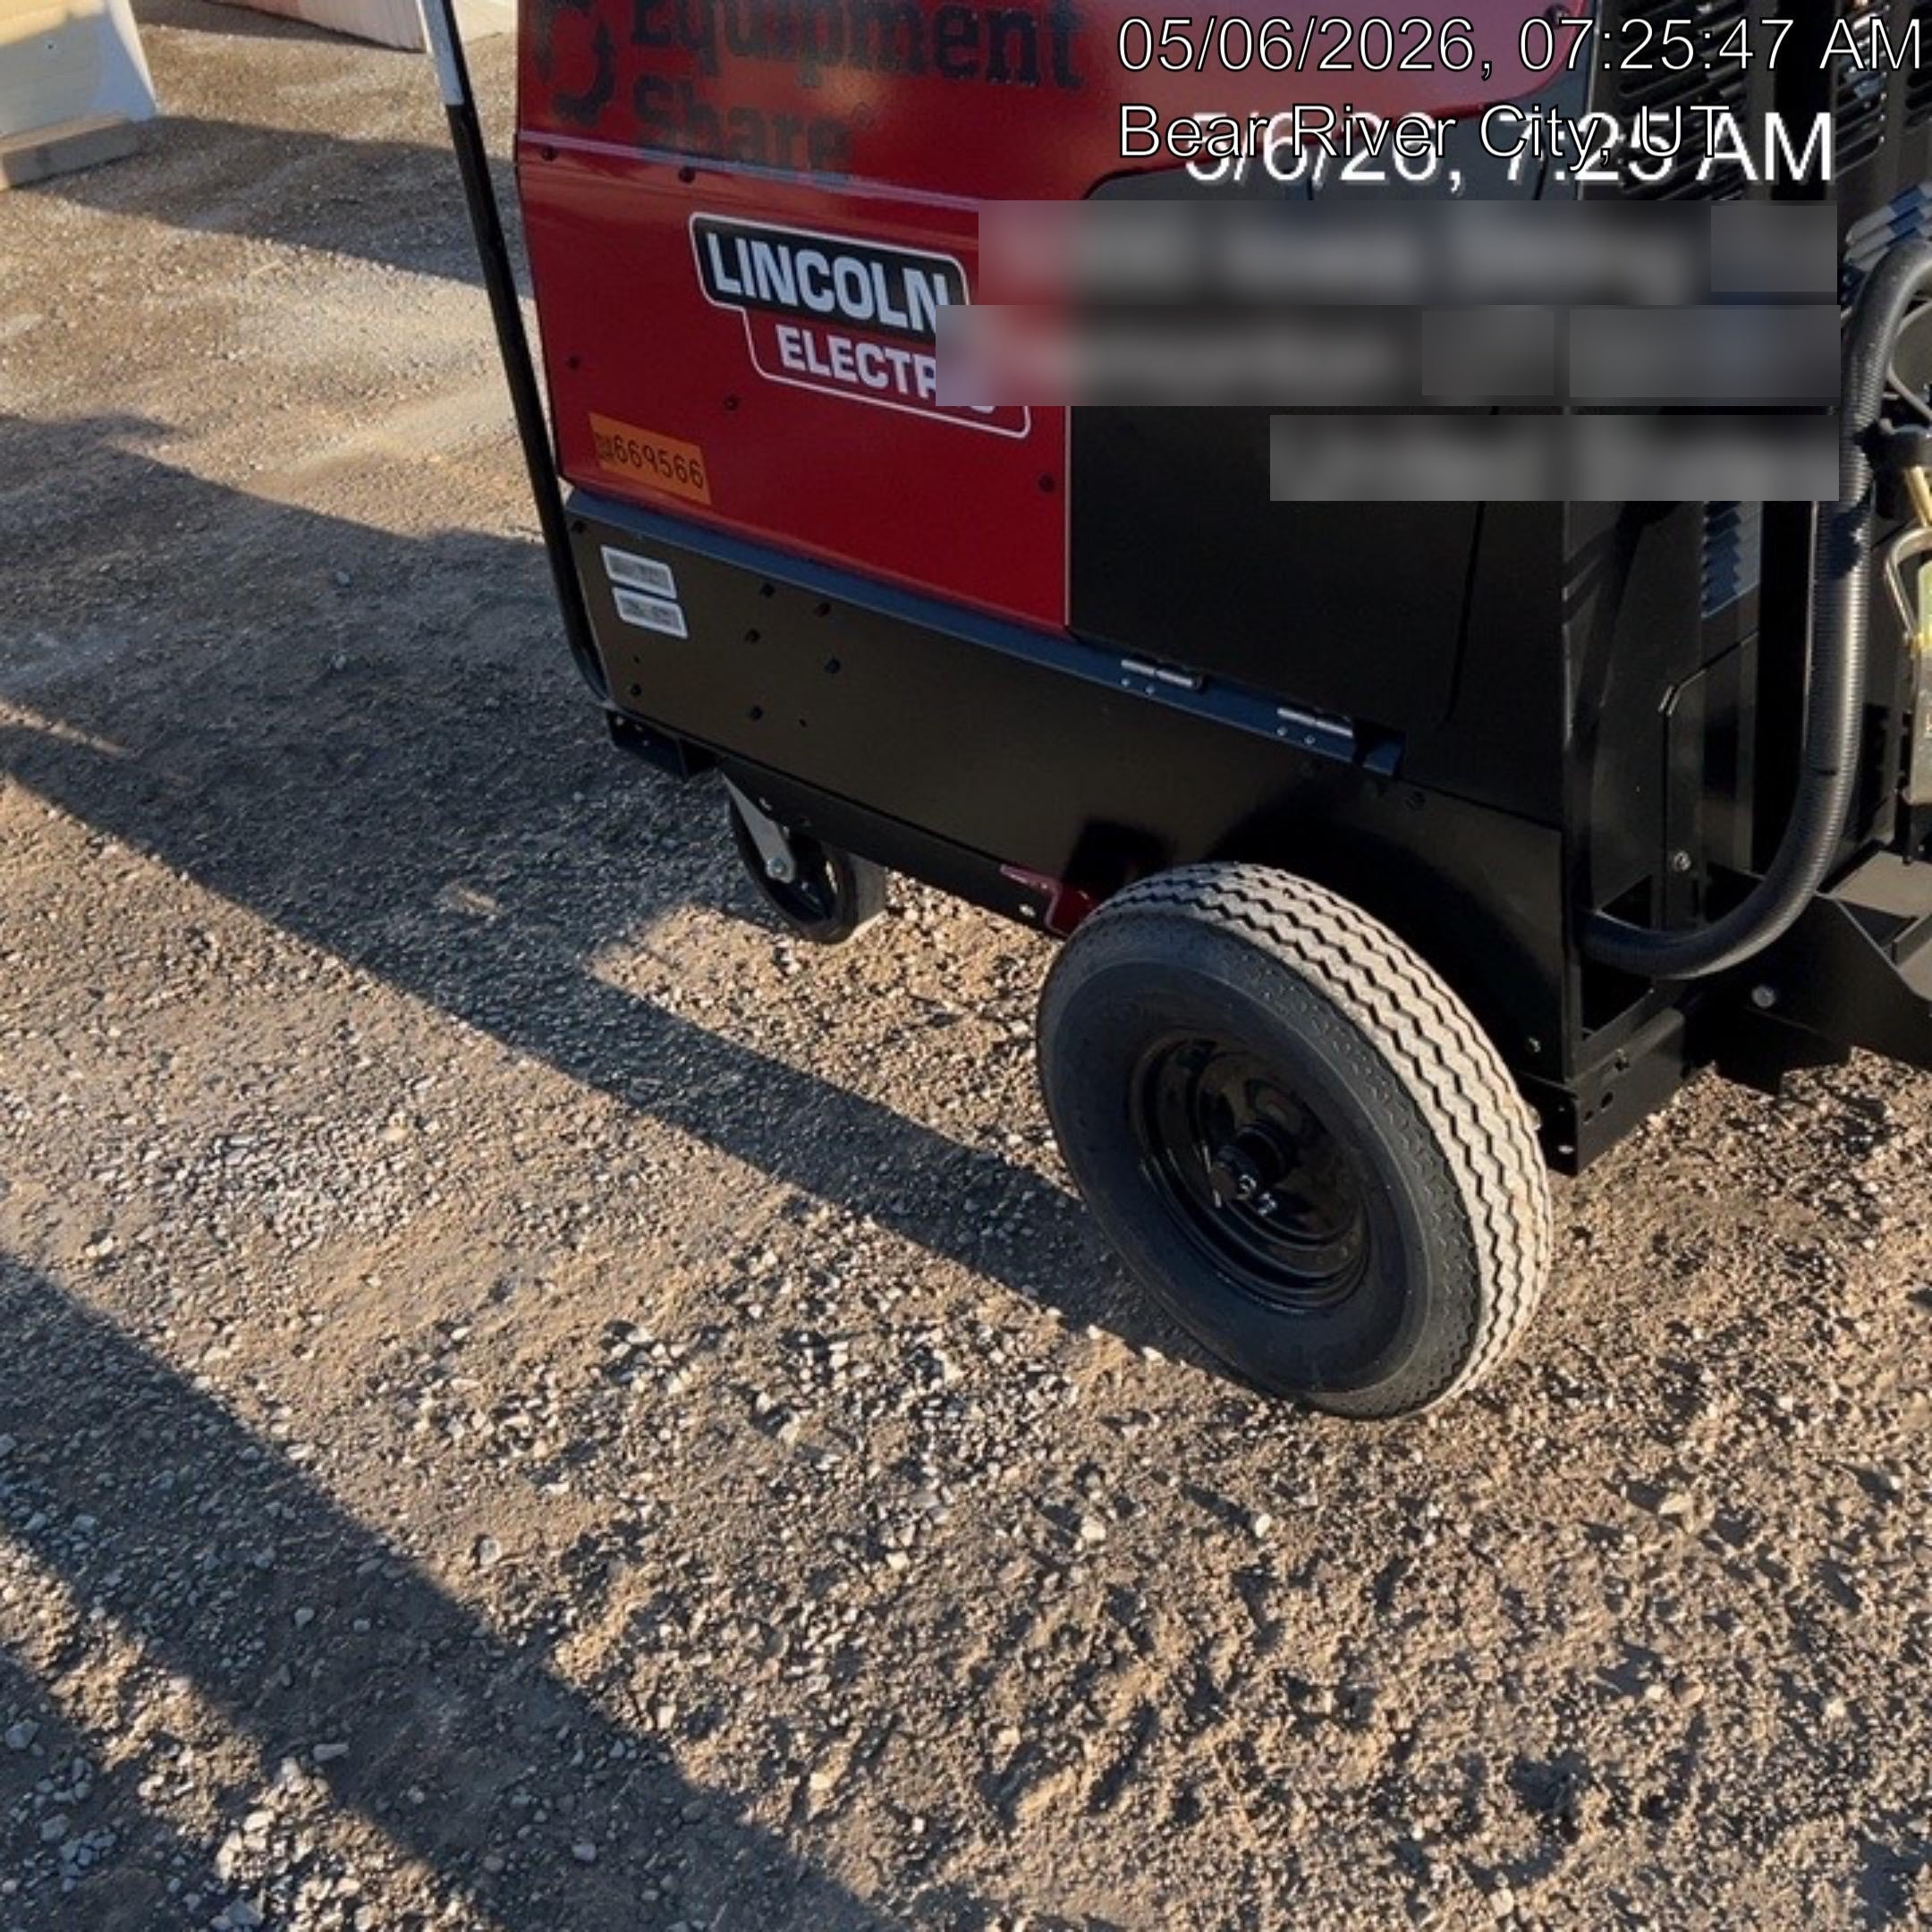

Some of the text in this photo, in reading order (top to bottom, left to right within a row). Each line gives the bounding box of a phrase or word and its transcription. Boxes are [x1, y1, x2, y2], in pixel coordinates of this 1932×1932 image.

[706, 232, 952, 334] LINCOLN
[775, 324, 996, 413] ELECTR
[614, 435, 704, 489] 669566
